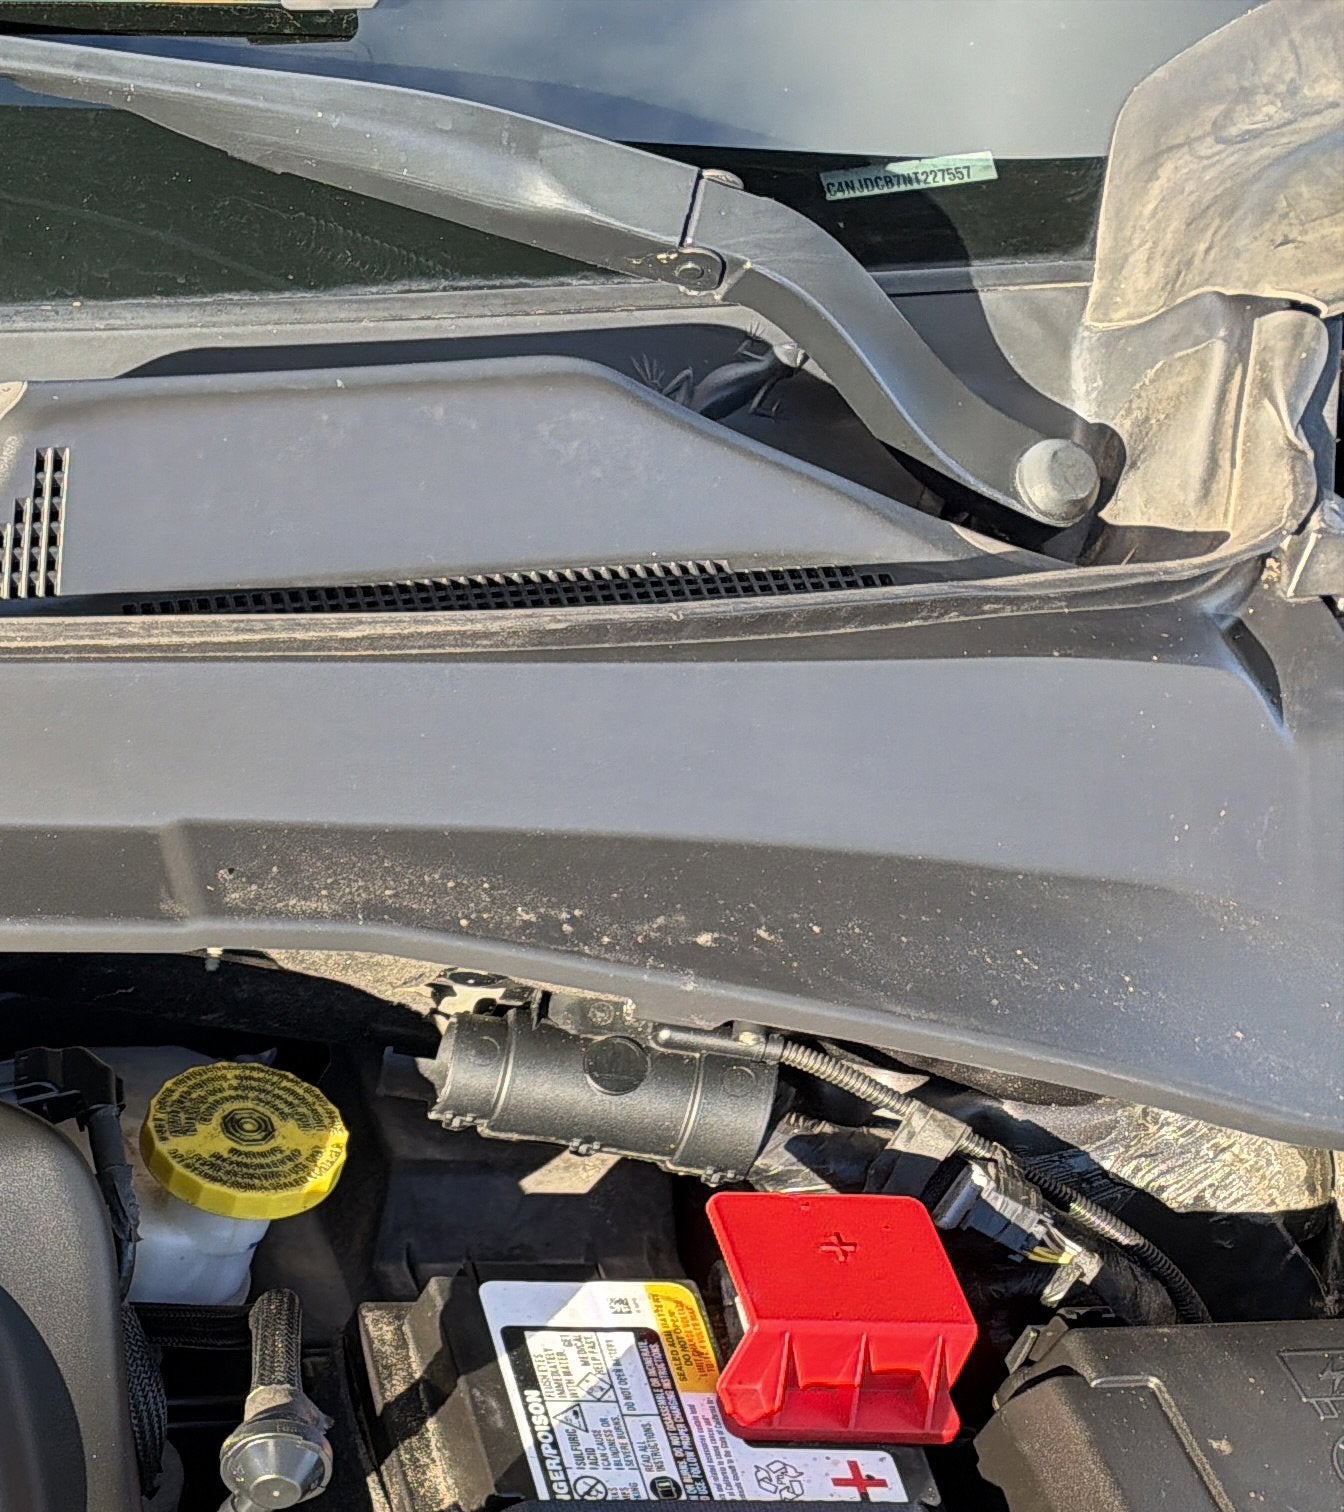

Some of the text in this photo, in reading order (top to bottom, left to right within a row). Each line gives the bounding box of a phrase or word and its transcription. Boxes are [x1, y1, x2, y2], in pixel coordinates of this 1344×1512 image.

[560, 1334, 573, 1347] GET
[675, 1335, 688, 1353] NOT
[533, 1354, 547, 1373] EYES
[590, 1356, 606, 1376] HELP
[671, 1350, 687, 1382] SEALED
[682, 1354, 693, 1366] DO
[543, 1348, 567, 1398] IMMEDIATELY
[612, 1368, 627, 1386] OPEN
[649, 1377, 660, 1388] OR
[565, 1378, 579, 1398] WITH
[618, 1387, 632, 1401] NOT
[625, 1401, 637, 1411] DO
[652, 1388, 675, 1432] DISASSEMBLE
[663, 1390, 684, 1424] CHARGING
[709, 1405, 723, 1429] California
[599, 1417, 623, 1467] BLINDNESS OR
[668, 1432, 681, 1447] NOT
[677, 1424, 694, 1451] PROPER
[565, 1429, 585, 1467] SULFURIC
[585, 1448, 599, 1467] ACID
[591, 1430, 611, 1467] CAN CAUSE
[619, 1441, 634, 1467] SEVERE
[636, 1440, 655, 1473] READ ALL
[673, 1446, 685, 1458] DO
[684, 1450, 703, 1478] FOLLOW
[707, 1464, 720, 1482] related
